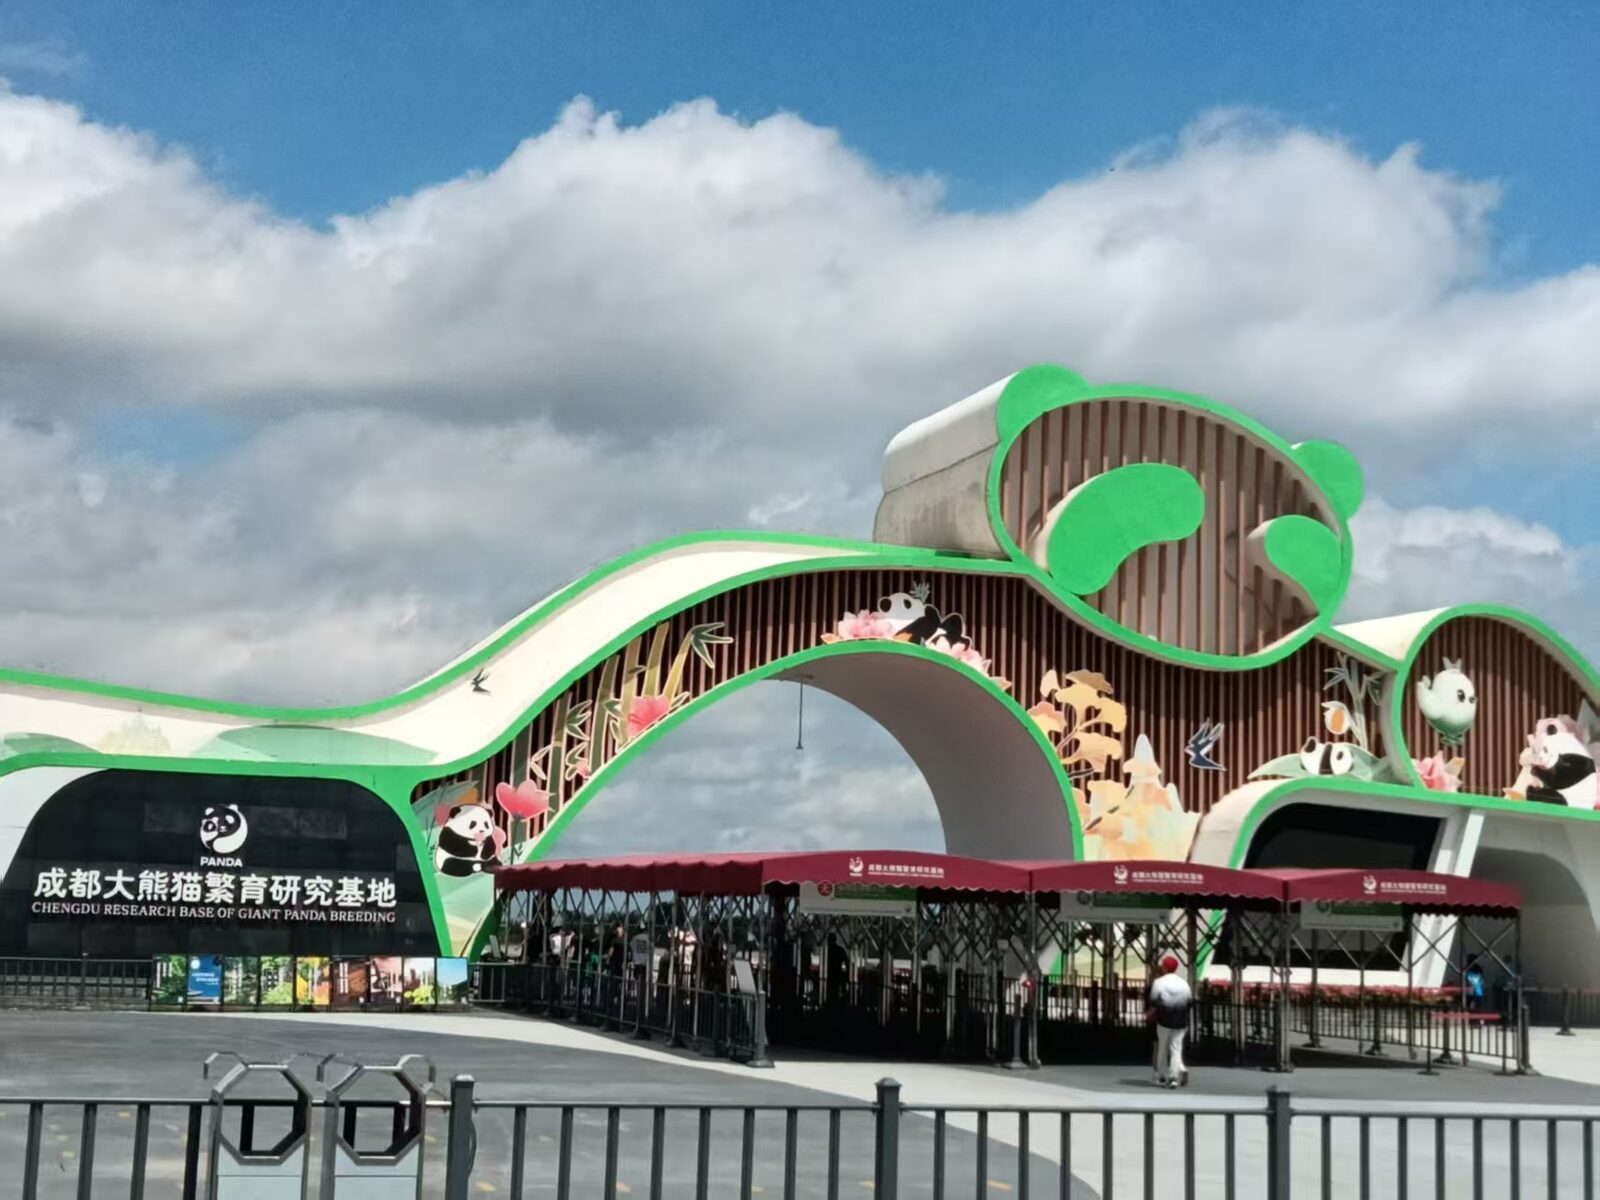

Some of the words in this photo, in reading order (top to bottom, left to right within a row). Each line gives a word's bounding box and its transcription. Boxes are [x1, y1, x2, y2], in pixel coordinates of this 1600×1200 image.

[200, 856, 243, 867] PANDA
[34, 866, 397, 908] 成都大熊猫繁育研究基地
[31, 902, 100, 915] CHENGDU
[103, 903, 176, 917] RESEARCH
[179, 906, 215, 918] BASE
[217, 907, 235, 919] OF
[238, 908, 280, 920] GIANT
[284, 909, 326, 922] PANDA
[330, 910, 396, 923] BREEDING
